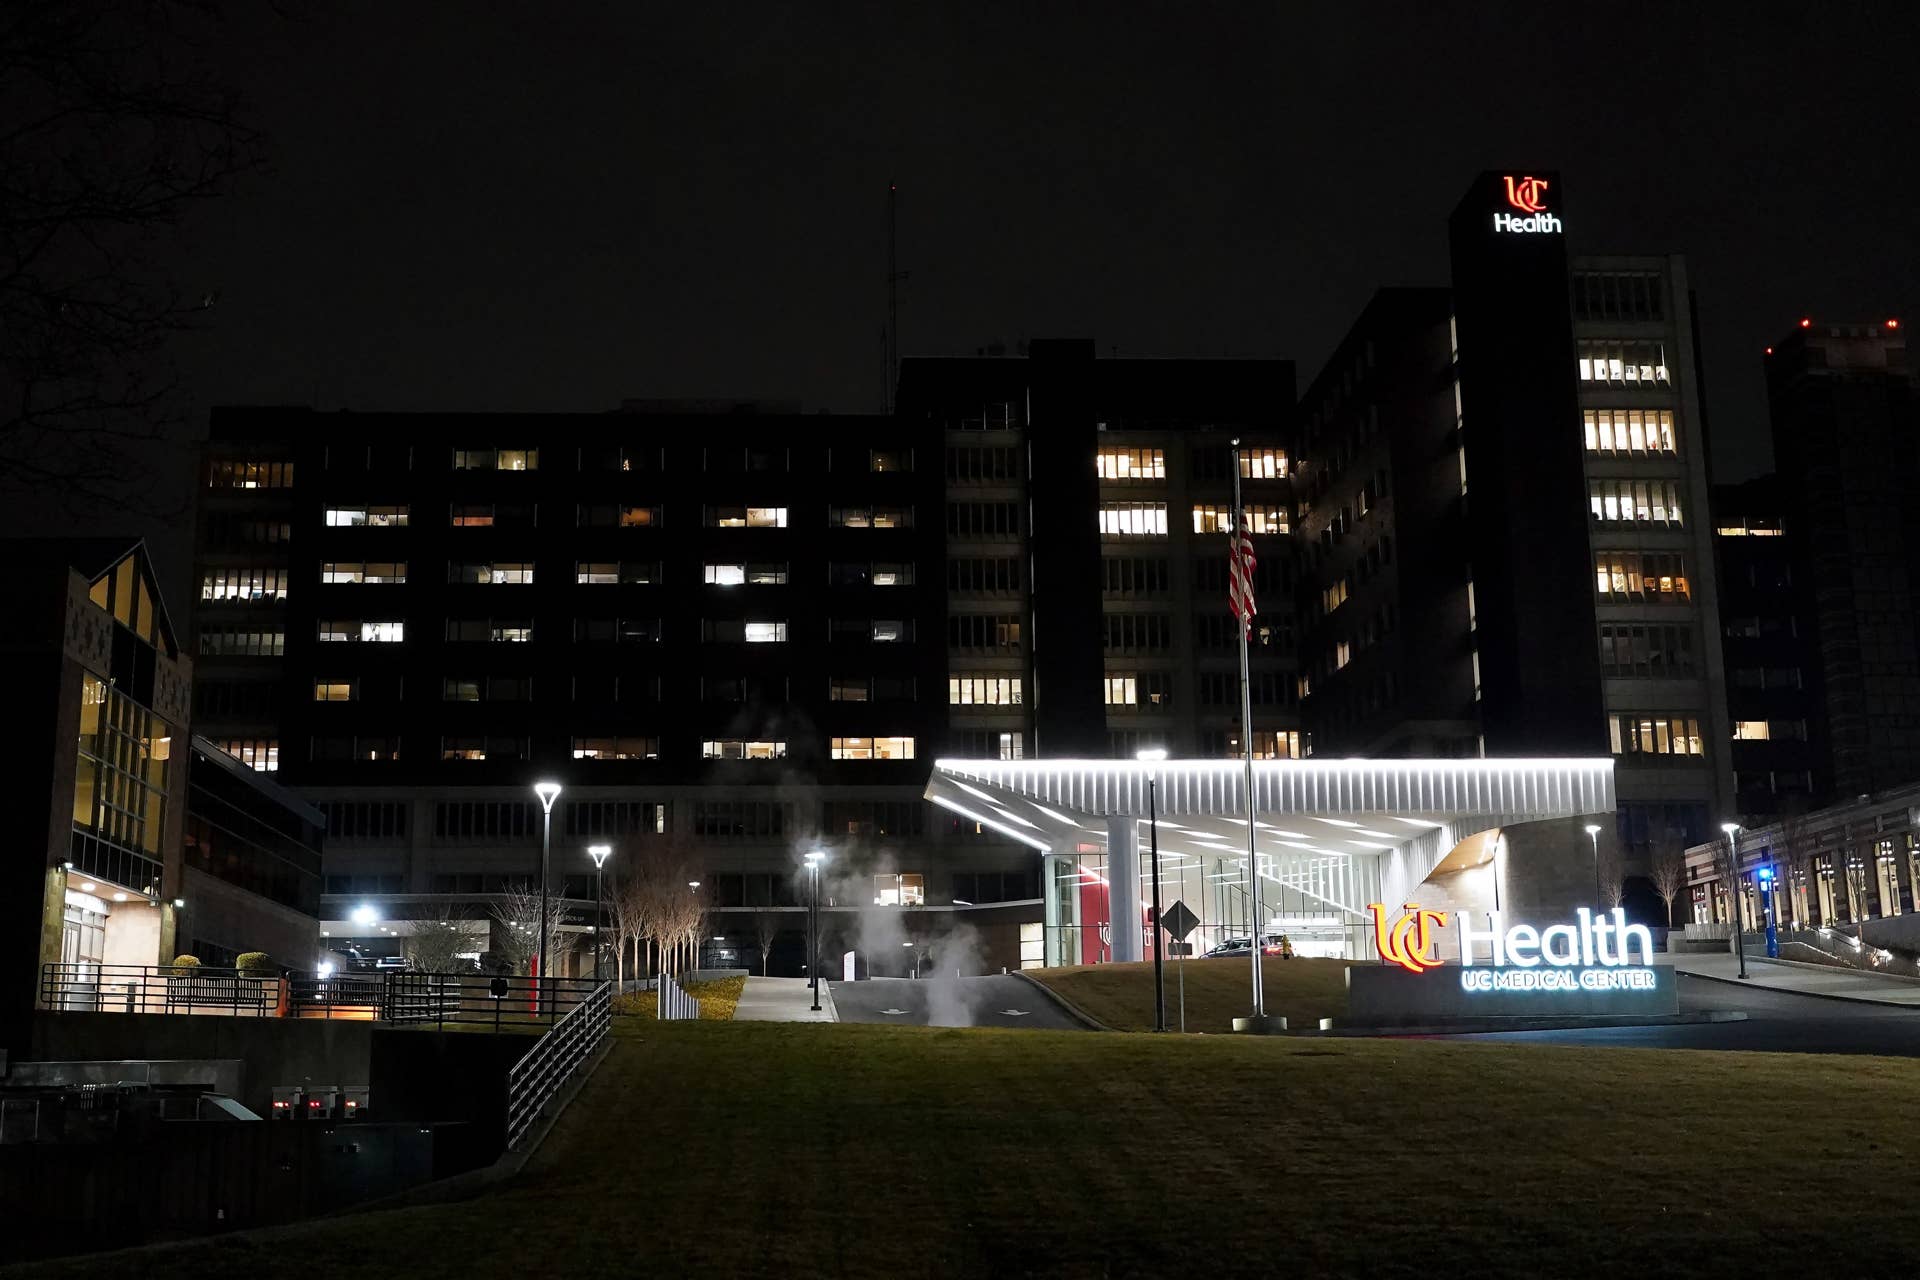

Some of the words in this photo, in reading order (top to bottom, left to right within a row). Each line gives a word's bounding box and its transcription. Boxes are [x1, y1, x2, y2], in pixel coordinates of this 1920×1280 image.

[1503, 176, 1548, 213] UC
[1493, 212, 1562, 233] Health
[1367, 903, 1448, 973] UC
[1455, 907, 1655, 967] Health
[1464, 971, 1491, 988] UC
[1496, 971, 1577, 988] MEDICAL
[1582, 971, 1655, 987] CENTER
